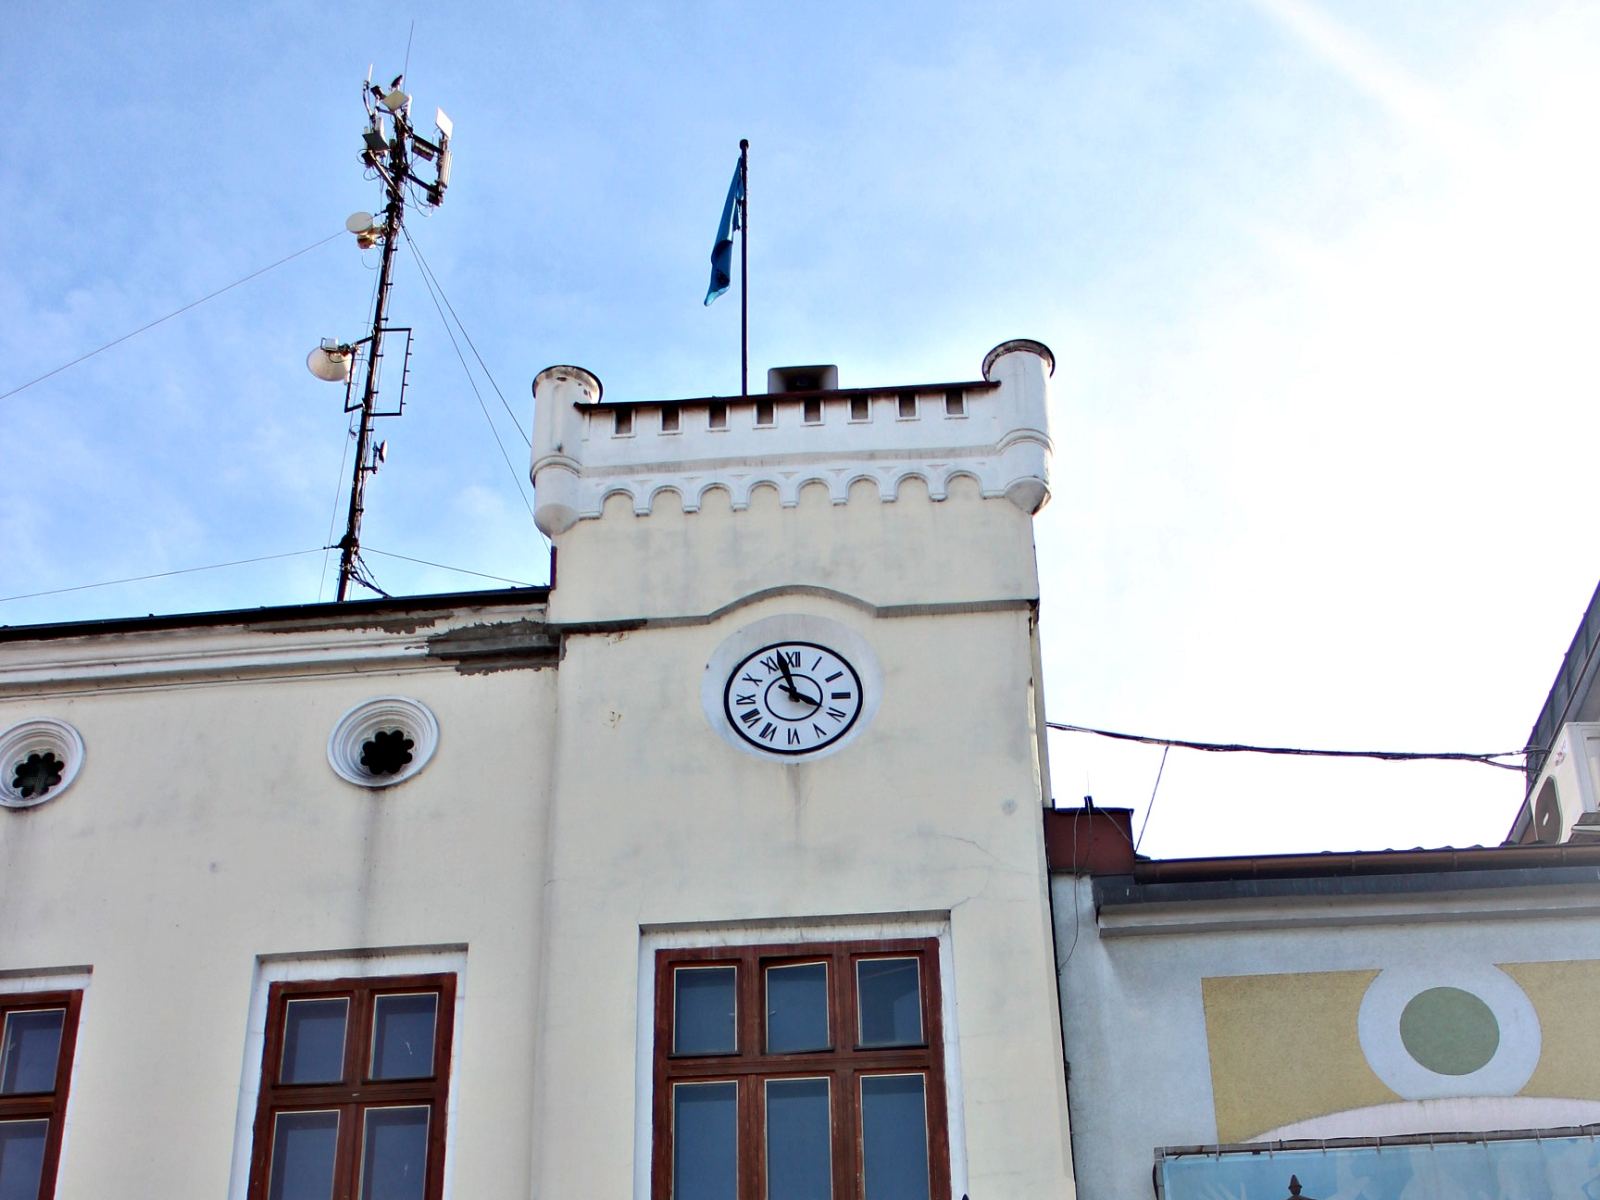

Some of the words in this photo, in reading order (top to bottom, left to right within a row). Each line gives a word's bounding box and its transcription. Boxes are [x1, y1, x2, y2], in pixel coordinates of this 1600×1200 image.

[760, 656, 779, 674] XI
[786, 652, 800, 668] XII
[742, 673, 763, 686] X
[813, 723, 827, 738] V
